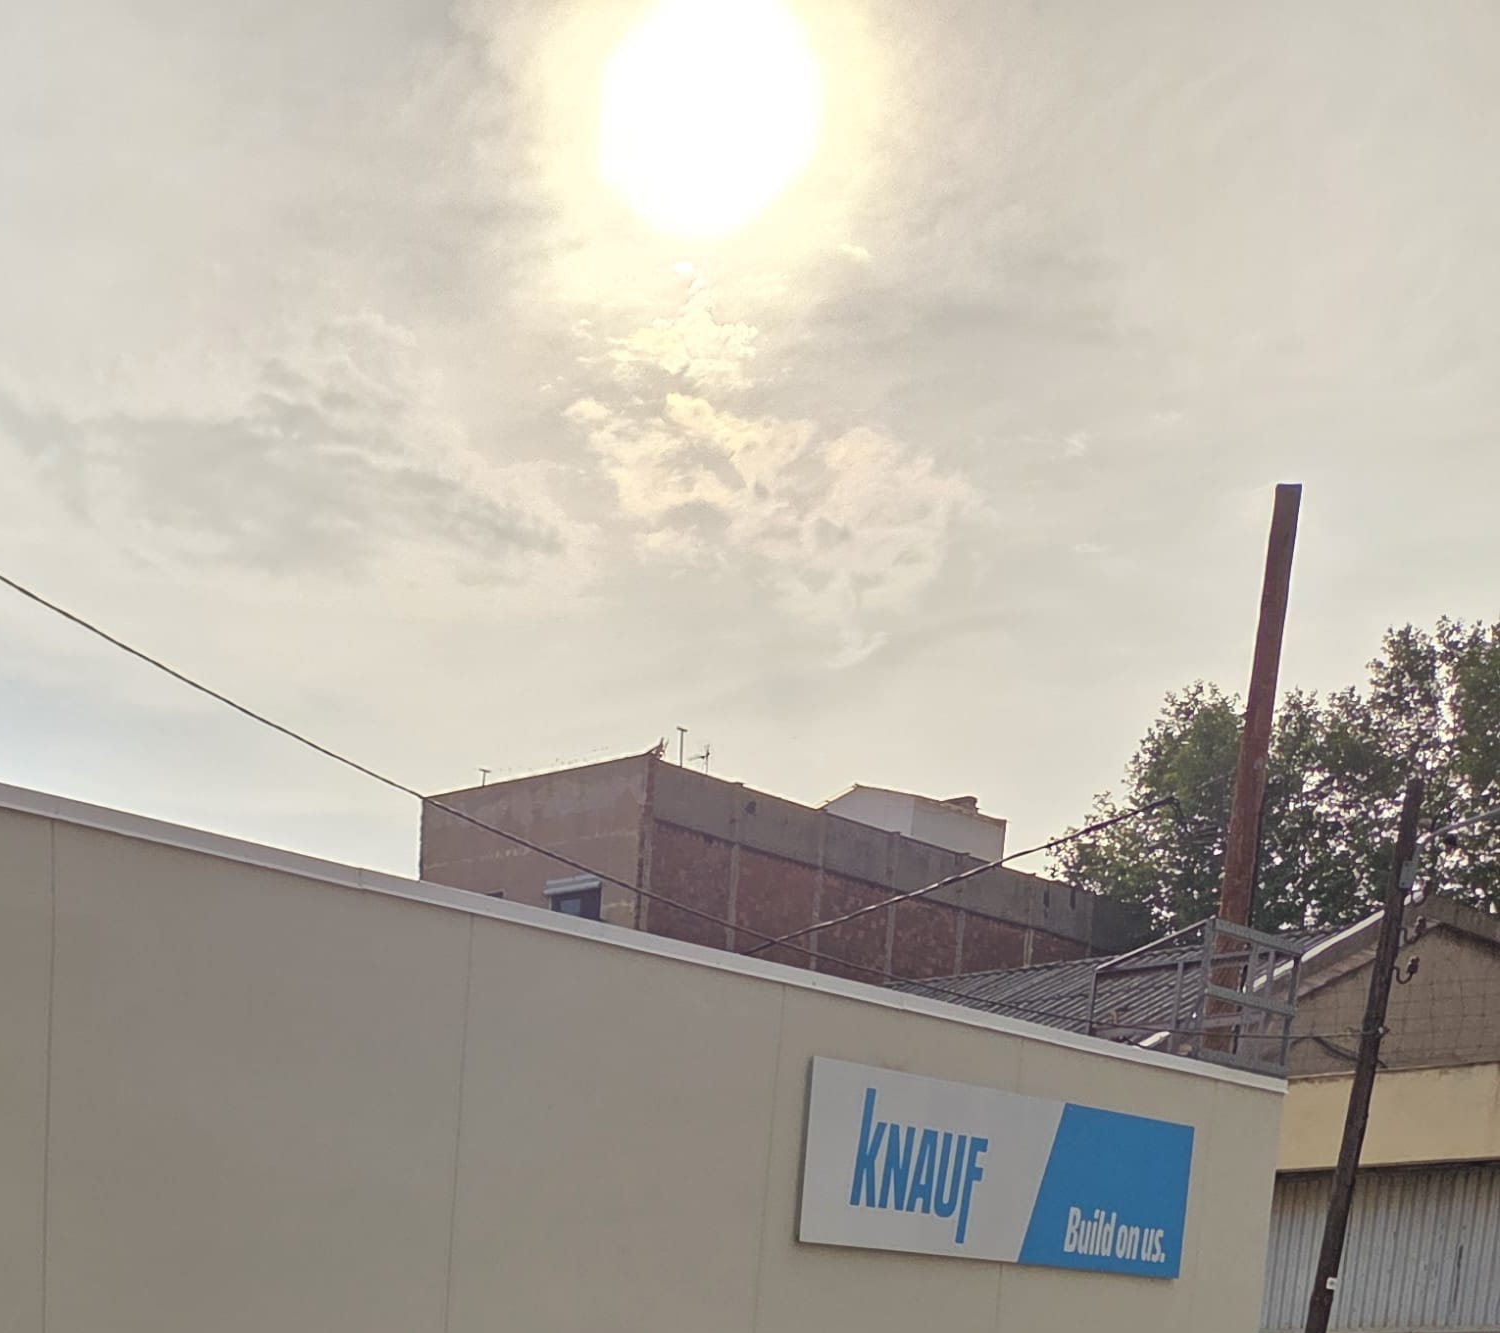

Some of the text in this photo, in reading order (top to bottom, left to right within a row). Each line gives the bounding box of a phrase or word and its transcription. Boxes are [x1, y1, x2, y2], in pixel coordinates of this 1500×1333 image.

[1063, 1206, 1166, 1263] Build on us.
